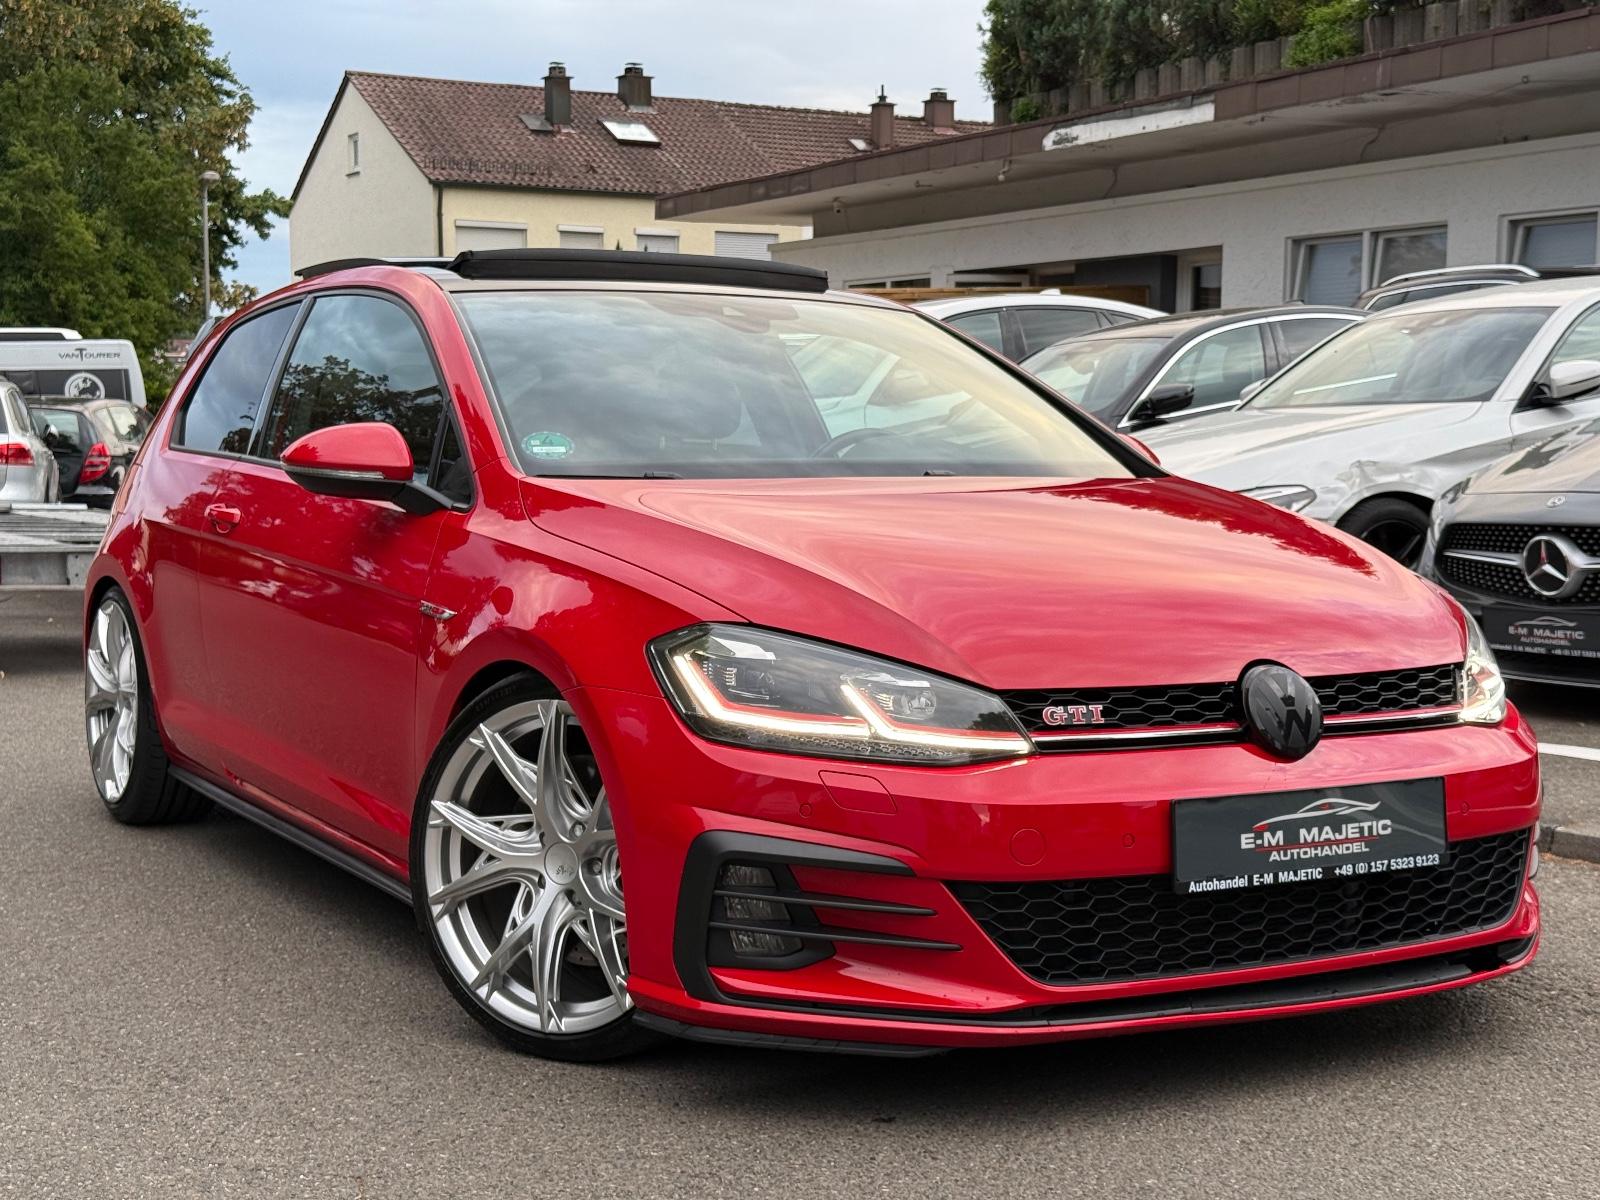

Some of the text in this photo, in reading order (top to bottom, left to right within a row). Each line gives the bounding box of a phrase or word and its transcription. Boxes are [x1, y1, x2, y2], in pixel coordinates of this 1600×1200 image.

[1508, 625, 1585, 640] E-M MAJETIC
[1042, 704, 1106, 727] GTI
[1240, 818, 1393, 850] E-M MAJETIC
[1269, 842, 1370, 862] AUTOHANDEL
[1189, 853, 1440, 893] Autohandel E-M MAJETIC +49 (0) 157 5323 9123
